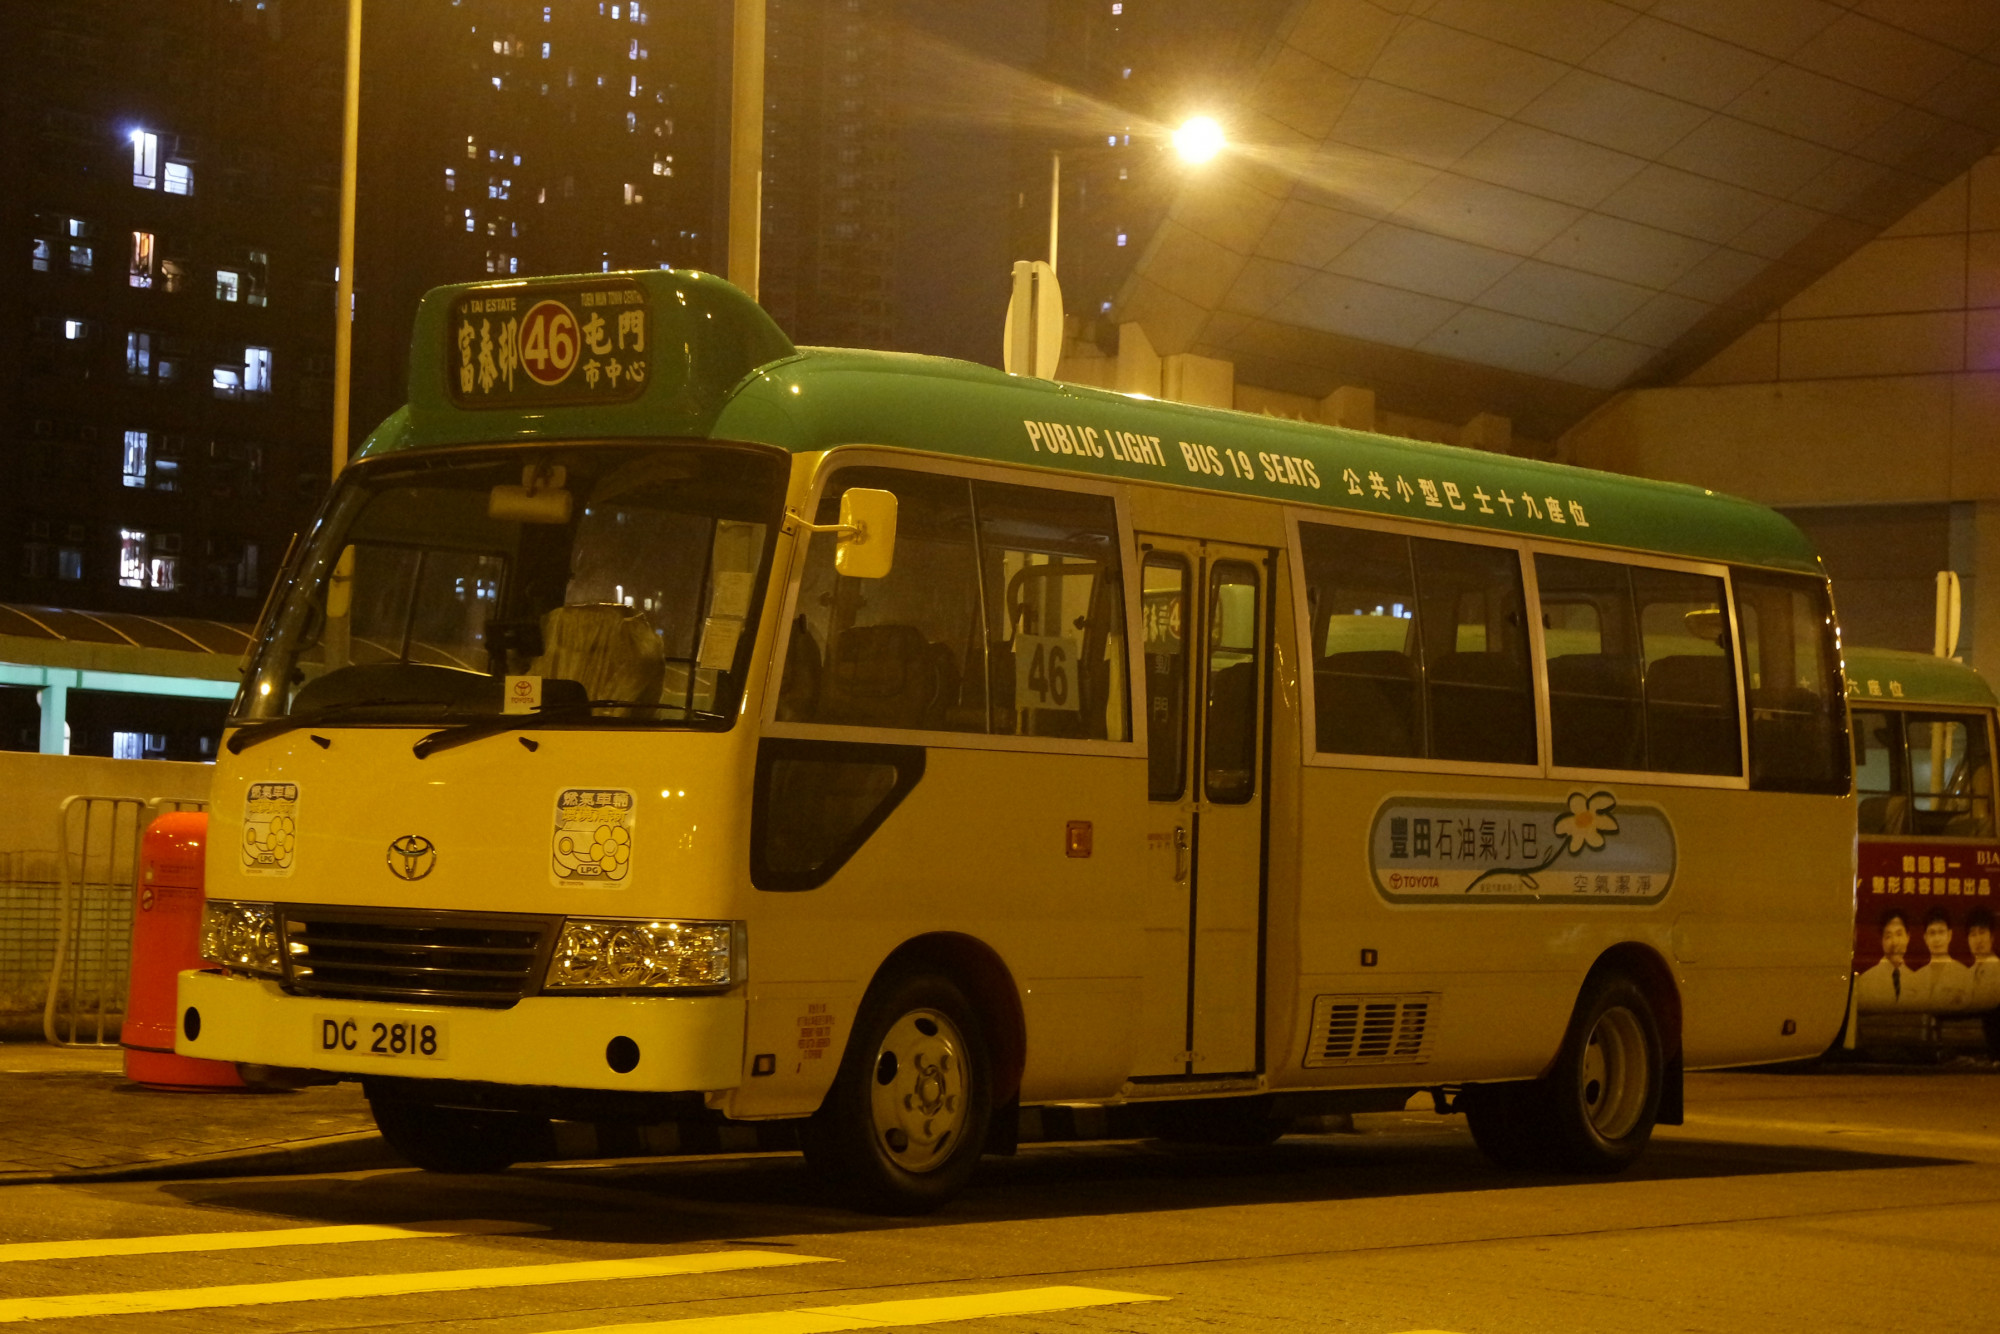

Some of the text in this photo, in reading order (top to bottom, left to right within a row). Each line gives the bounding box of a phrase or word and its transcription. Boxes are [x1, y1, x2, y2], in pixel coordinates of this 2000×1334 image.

[471, 299, 484, 313] TAI
[485, 297, 517, 313] ESTATE
[458, 315, 518, 395] 富泰邨
[523, 313, 574, 371] 46
[582, 309, 646, 355] 屯門
[582, 357, 646, 390] 市中心
[1024, 419, 1321, 490] PUBLIC LIGHT BUS 19 SEATS
[1341, 466, 1590, 529] 公共小型巴士十九座位
[1027, 642, 1069, 706] 46
[1389, 816, 1539, 862] 豐田石油氣小巴
[580, 866, 599, 874] LPG
[1403, 875, 1440, 889] TOYOTA
[1572, 874, 1653, 895] 空氣潔淨
[322, 1018, 438, 1057] DC 2818
